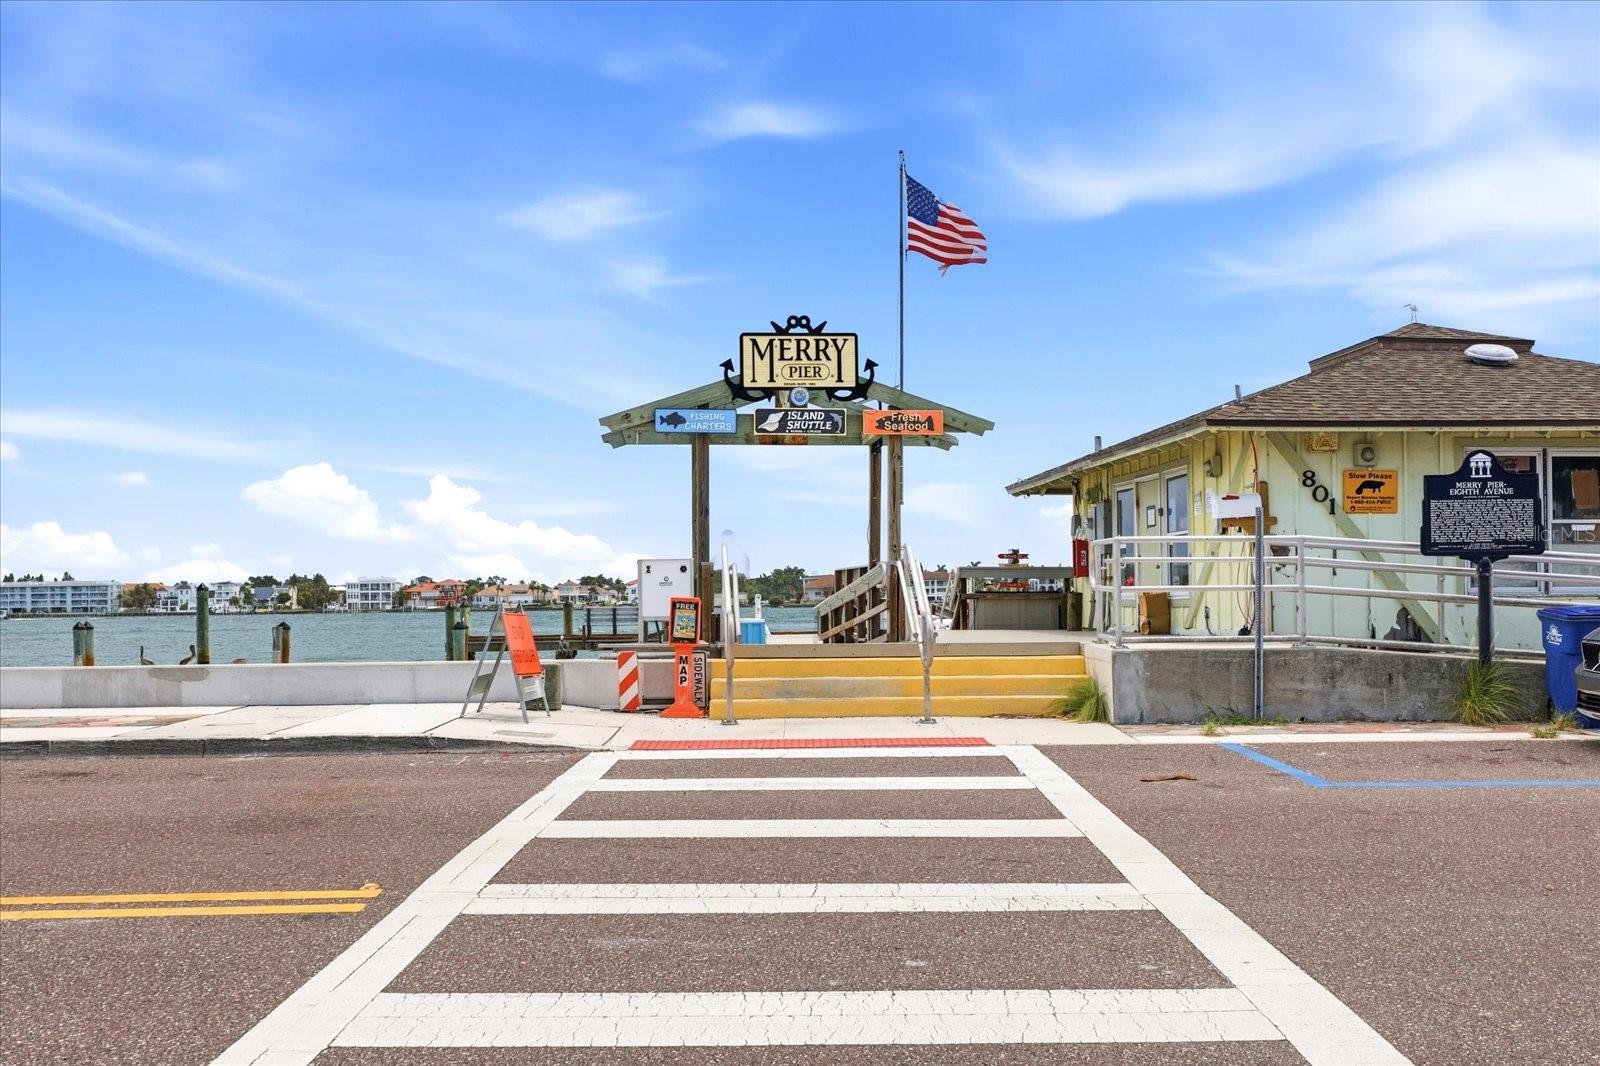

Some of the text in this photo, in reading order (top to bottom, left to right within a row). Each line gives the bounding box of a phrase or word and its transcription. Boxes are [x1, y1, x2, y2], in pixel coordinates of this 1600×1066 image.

[749, 338, 849, 383] MERRY
[788, 365, 823, 378] PIER
[690, 412, 725, 421] FISHING
[787, 411, 825, 420] ISLAND
[891, 412, 921, 421] Fresh
[685, 422, 732, 431] CHARTERS
[786, 421, 832, 430] SHUTTLE
[884, 421, 929, 431] Seafood
[1455, 481, 1482, 489] MERRY
[1302, 470, 1336, 515] 801
[676, 602, 695, 610] FREE
[680, 656, 688, 685] MAP
[694, 657, 703, 704] SIDEWALK
